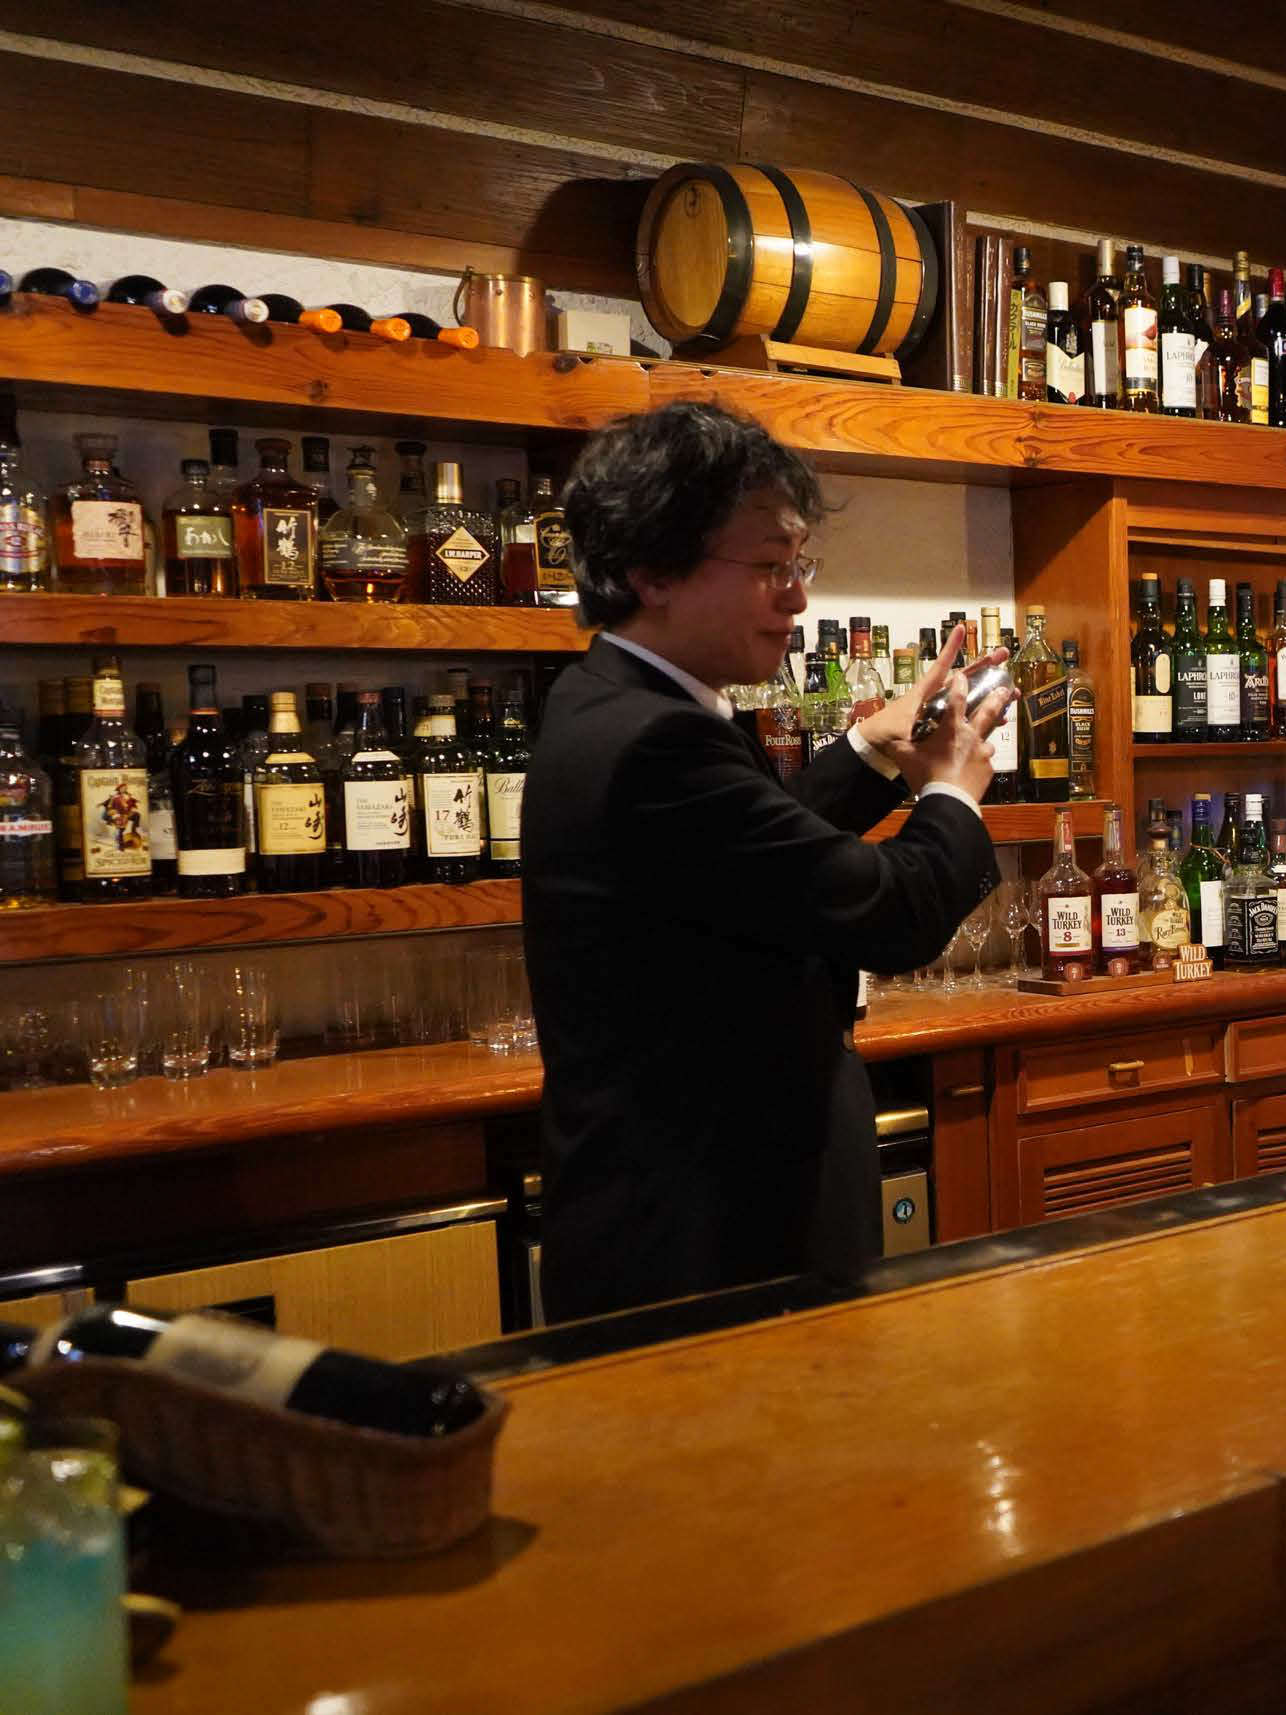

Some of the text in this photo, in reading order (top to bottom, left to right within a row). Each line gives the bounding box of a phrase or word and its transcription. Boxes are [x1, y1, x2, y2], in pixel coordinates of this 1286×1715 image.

[435, 810, 449, 821] 17
[1057, 911, 1078, 920] WILD
[1110, 907, 1131, 917] WILD
[1248, 907, 1261, 918] JACK
[1052, 918, 1081, 930] TURKEY
[1105, 914, 1133, 926] TURKEY
[1063, 931, 1072, 942] 8
[1116, 928, 1126, 937] 13
[1180, 946, 1206, 962] WILD
[1174, 961, 1212, 980] TURKEY
